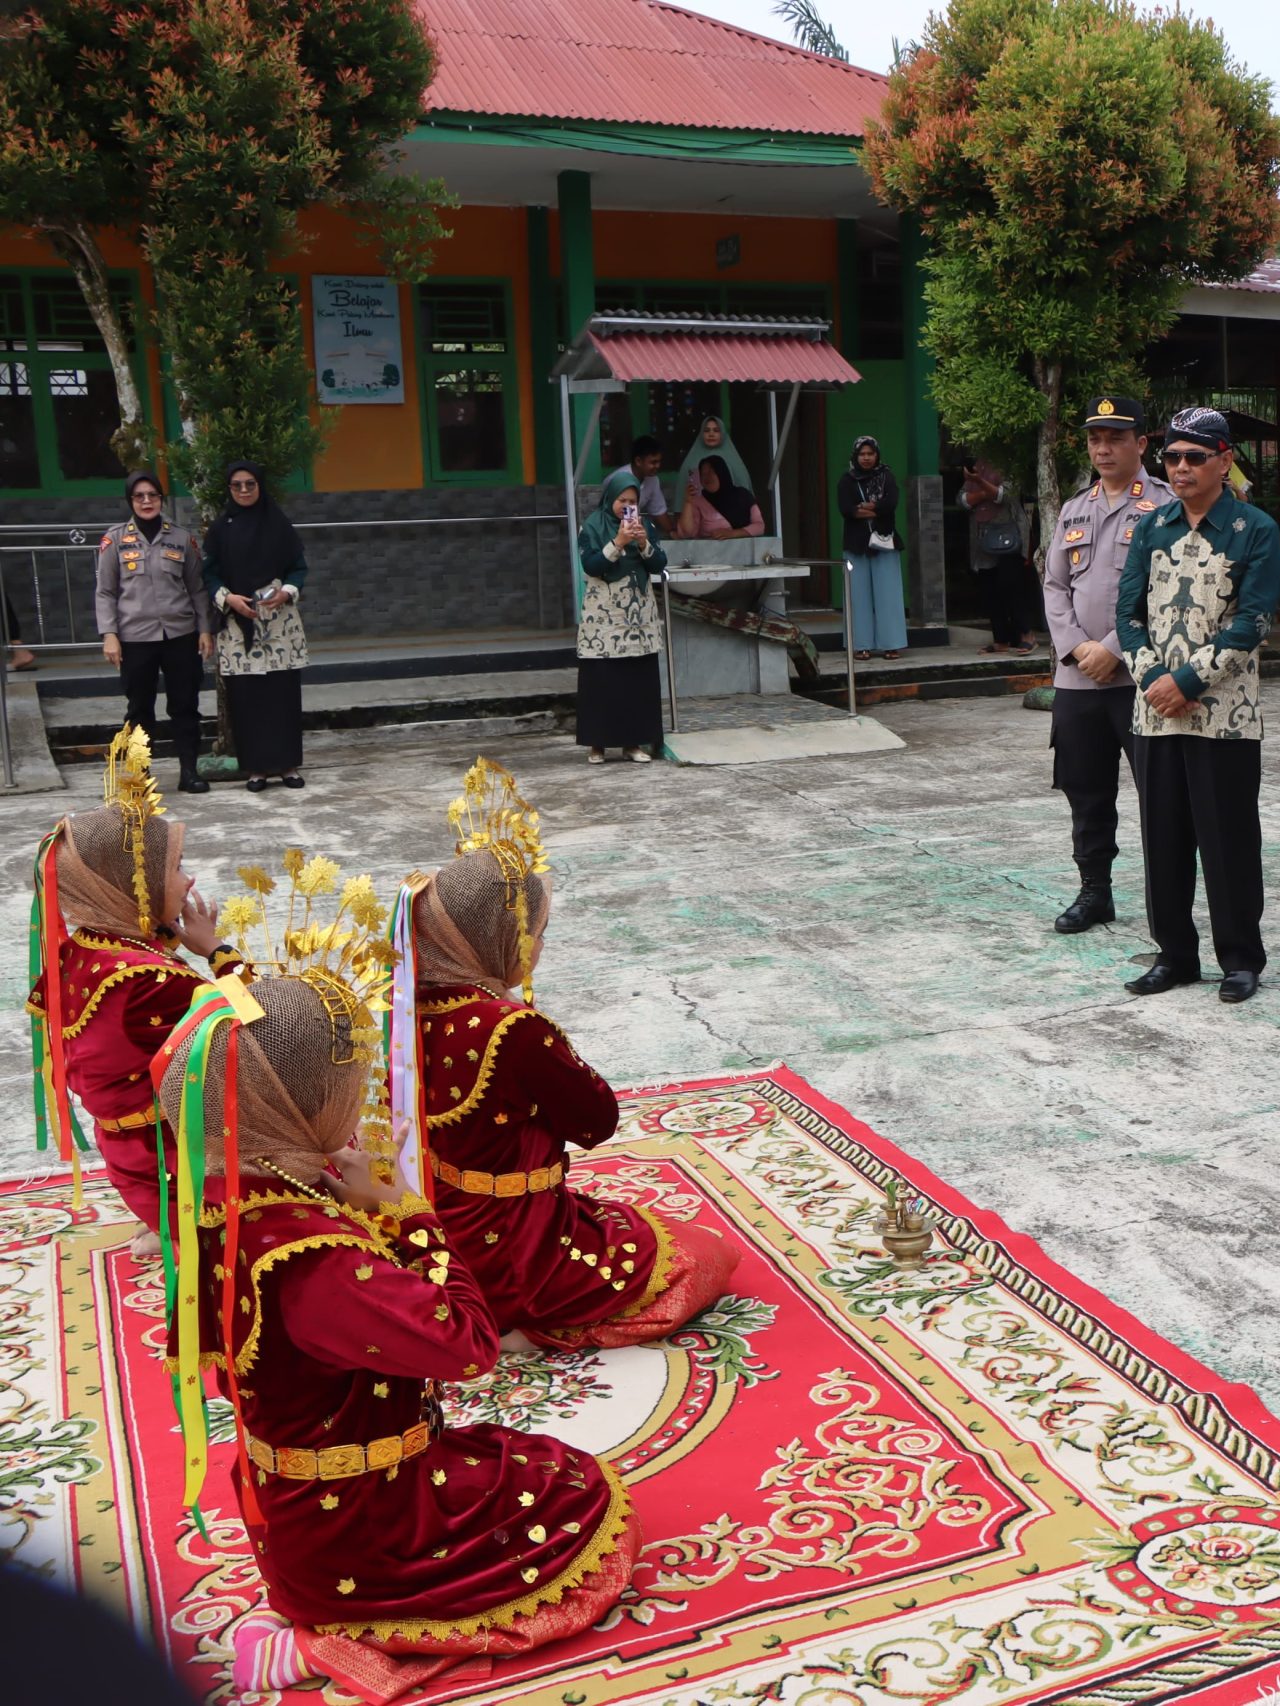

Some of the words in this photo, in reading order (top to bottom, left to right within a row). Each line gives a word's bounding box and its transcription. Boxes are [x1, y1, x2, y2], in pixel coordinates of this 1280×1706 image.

[328, 289, 383, 309] Belajar
[342, 321, 374, 337] Ilmu
[1126, 513, 1143, 522] PO
